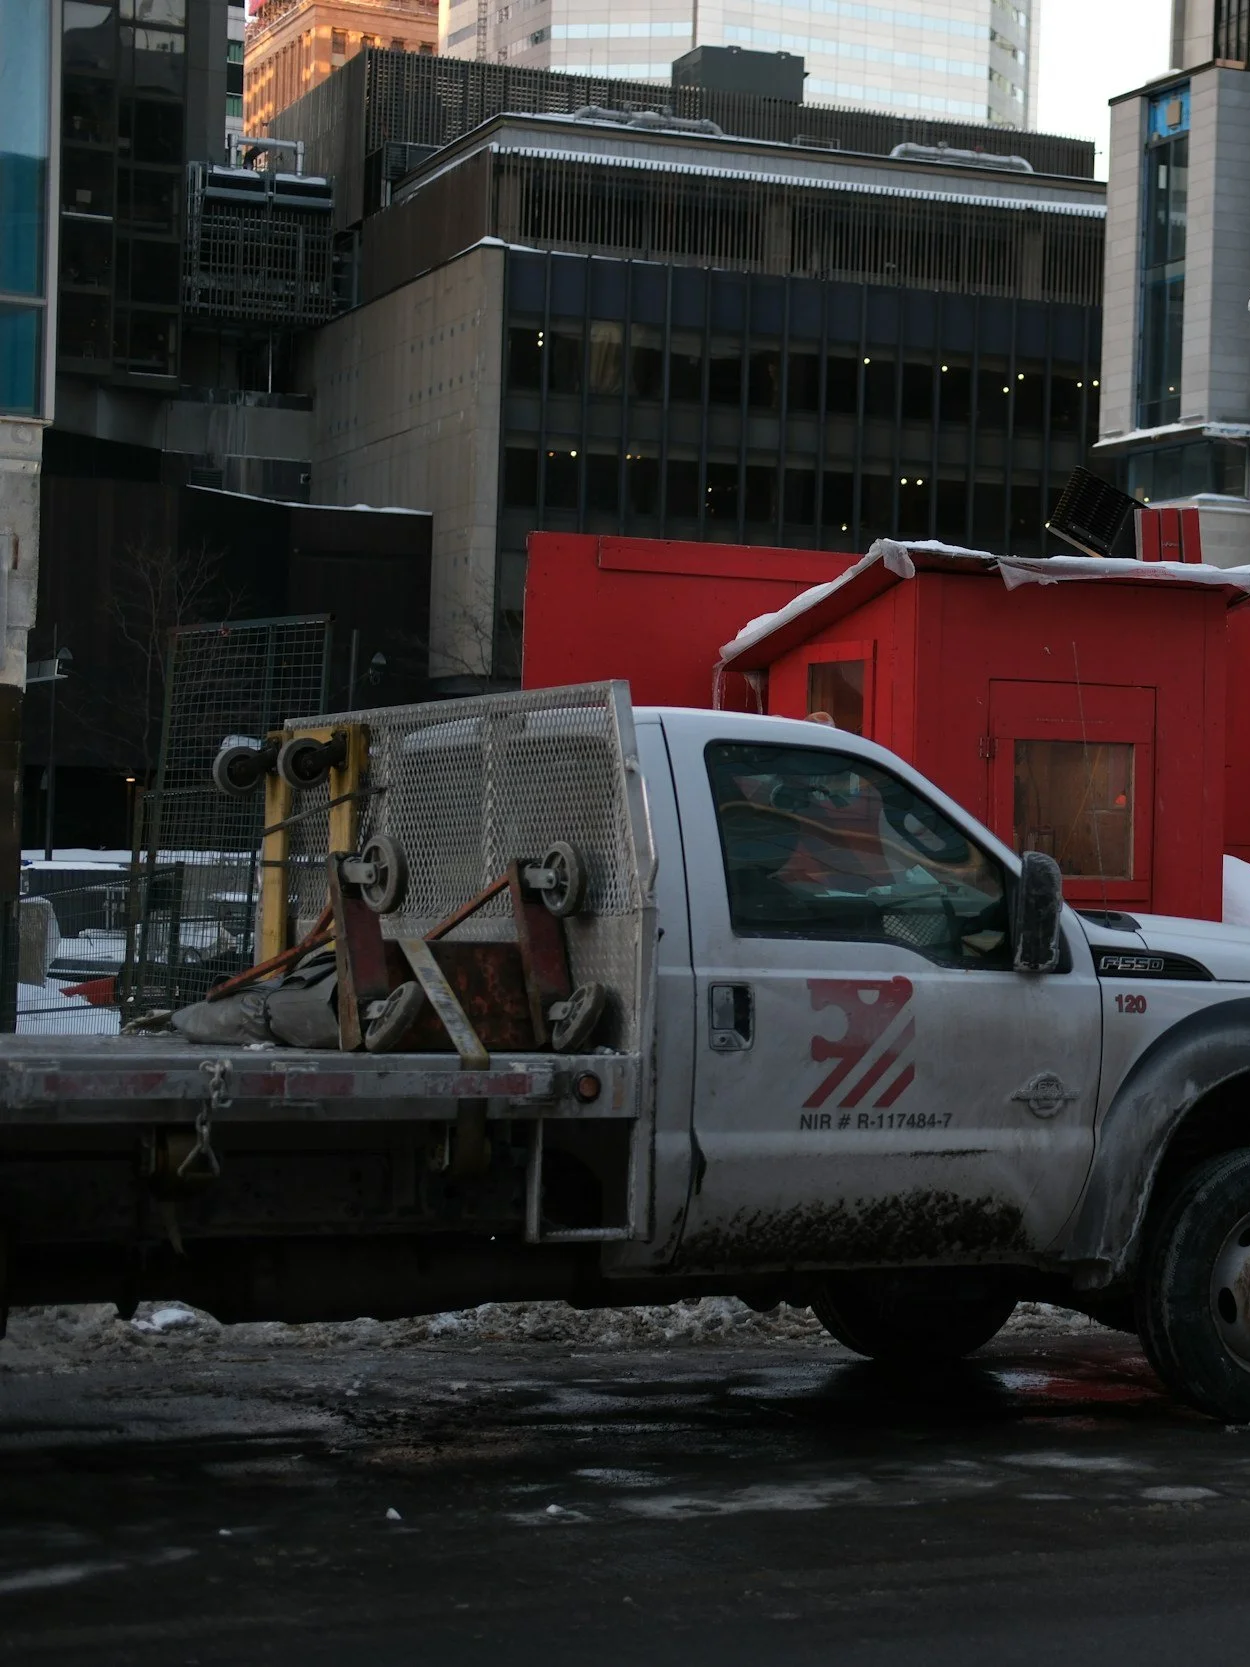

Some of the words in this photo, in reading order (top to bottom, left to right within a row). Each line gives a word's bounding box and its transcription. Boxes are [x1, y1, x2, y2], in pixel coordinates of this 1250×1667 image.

[1115, 994, 1147, 1014] 120
[800, 1113, 832, 1130] NIR
[838, 1114, 851, 1130] #
[857, 1112, 953, 1130] R-117484-7
